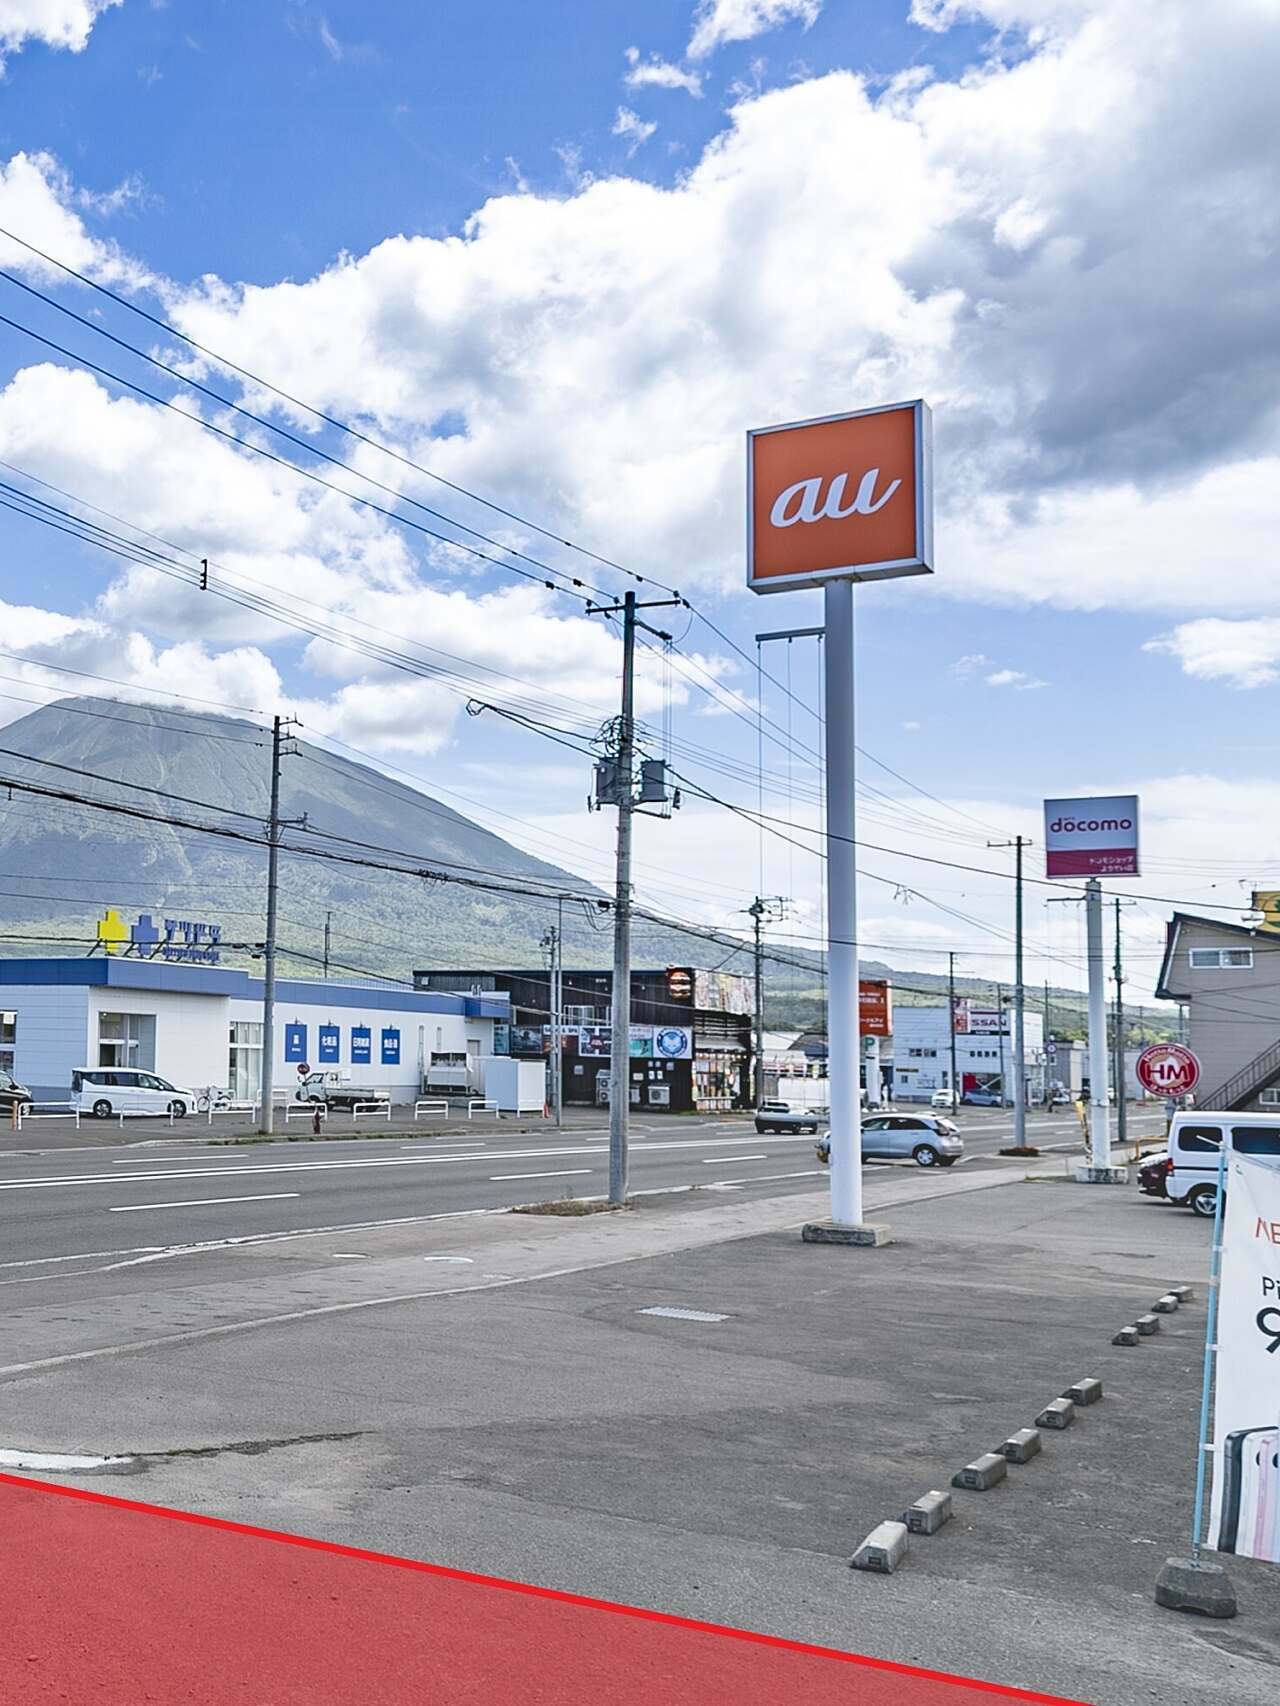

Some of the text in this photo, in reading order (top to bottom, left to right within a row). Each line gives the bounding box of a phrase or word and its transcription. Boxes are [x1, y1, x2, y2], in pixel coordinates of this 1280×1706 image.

[770, 467, 902, 528] au
[1050, 817, 1132, 833] docomo
[1146, 1063, 1189, 1081] HM
